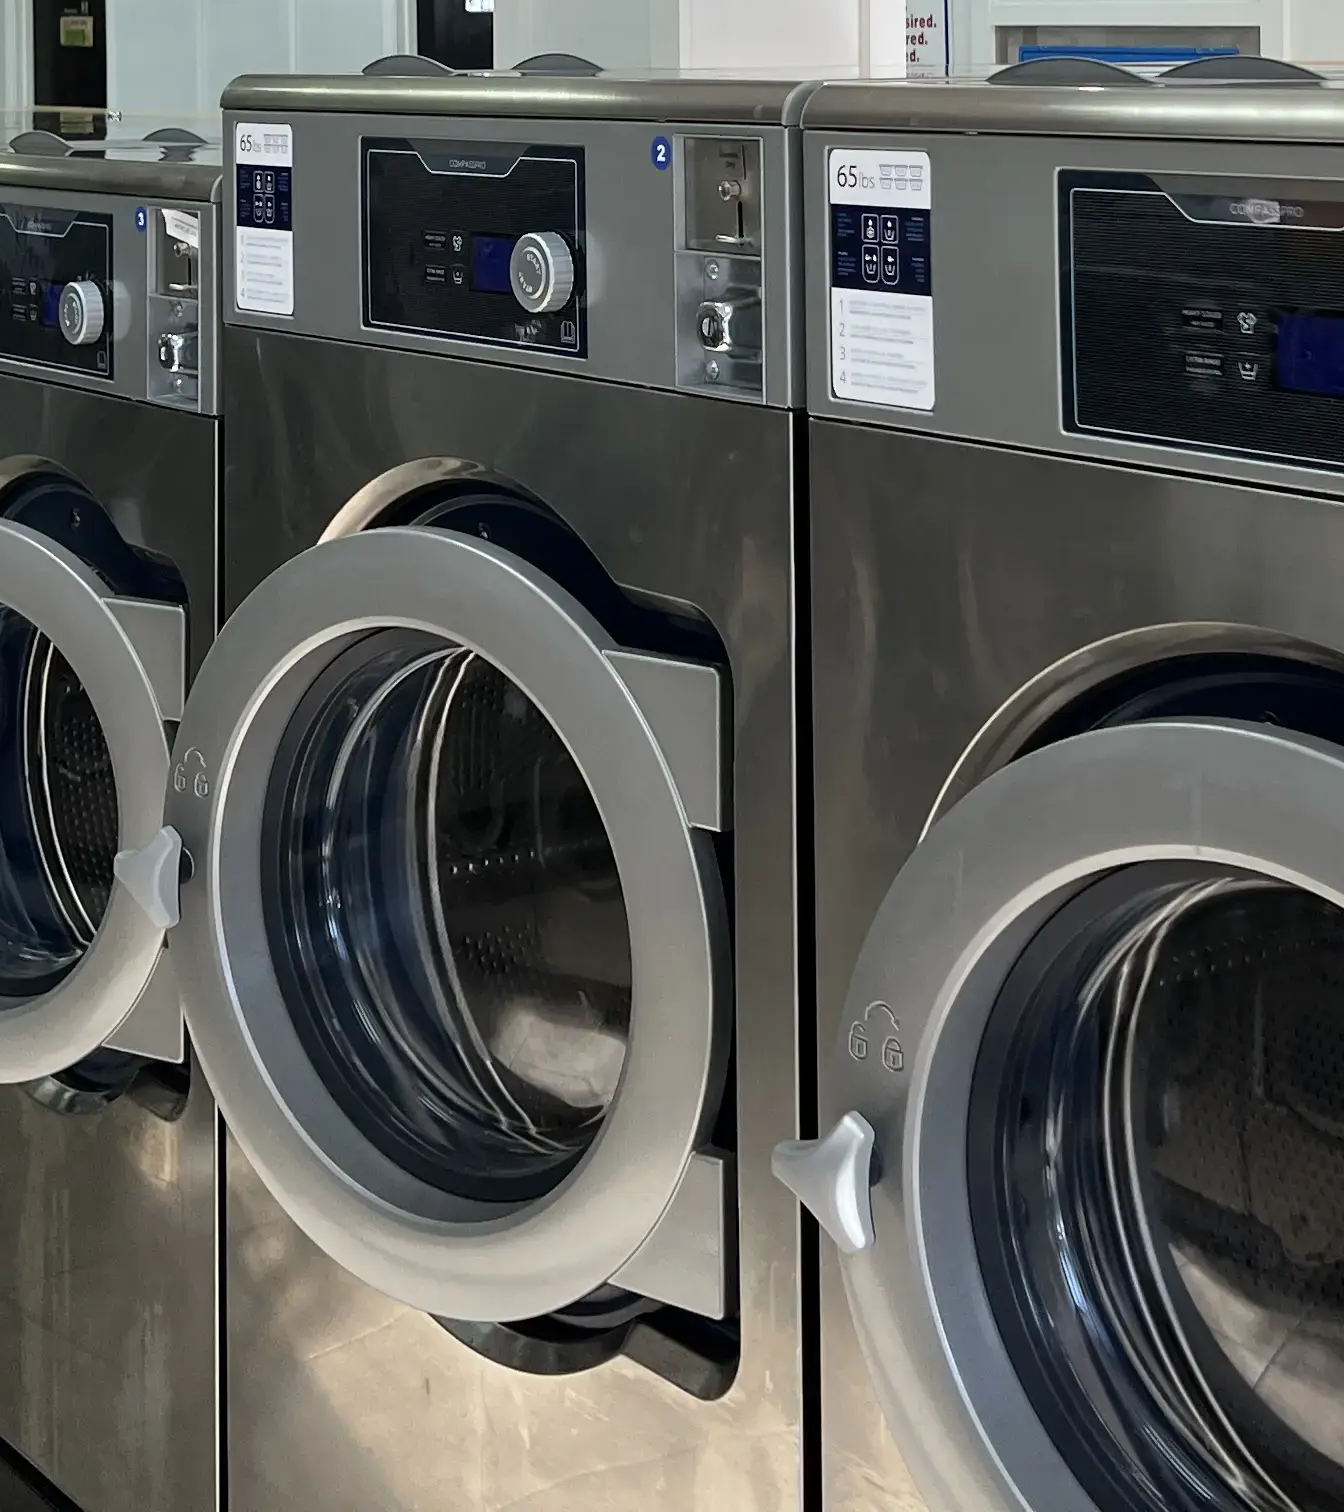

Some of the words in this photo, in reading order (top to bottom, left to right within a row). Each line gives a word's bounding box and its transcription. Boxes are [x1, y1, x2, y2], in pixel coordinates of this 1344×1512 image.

[656, 144, 666, 162] 2
[138, 212, 145, 226] 3
[839, 323, 846, 337] 2
[839, 346, 846, 361] 3
